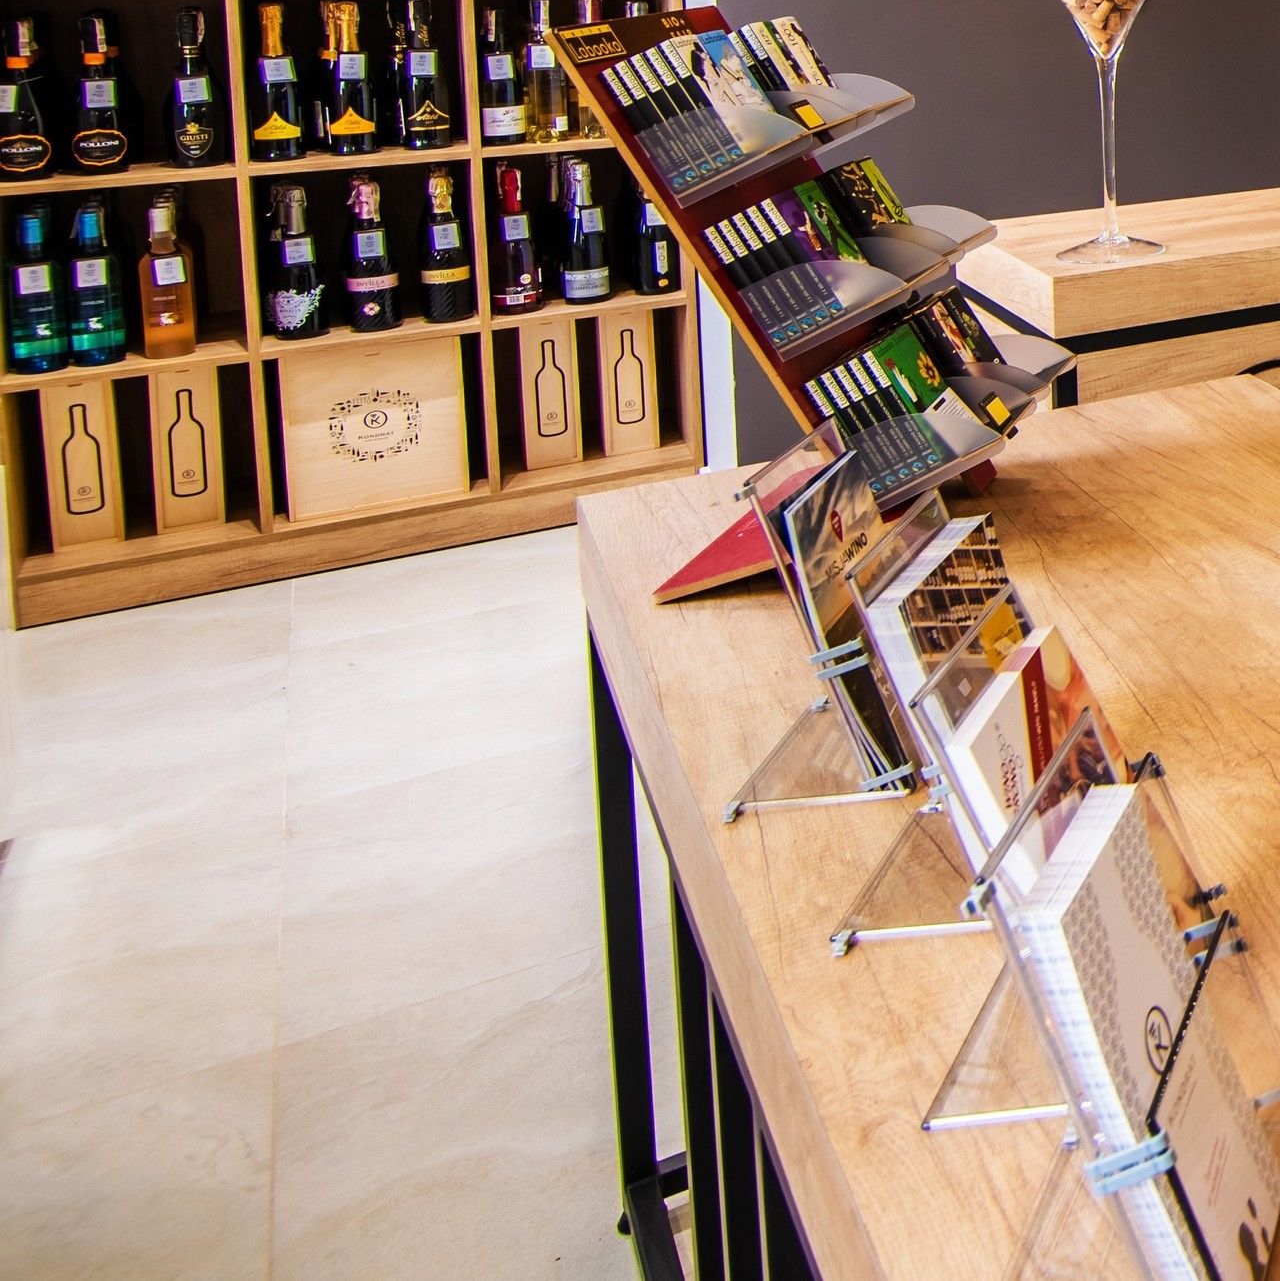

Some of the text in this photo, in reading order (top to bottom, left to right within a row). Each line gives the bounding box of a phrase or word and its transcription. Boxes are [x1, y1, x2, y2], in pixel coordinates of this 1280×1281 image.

[568, 39, 623, 61] Labooko
[666, 42, 692, 79] Labooko
[620, 63, 646, 101] Labooko
[636, 56, 662, 94] Labooko
[651, 50, 677, 87] Labooko
[607, 70, 634, 107] Labooko
[179, 133, 209, 142] GIUSTI
[736, 214, 764, 251] Labooko
[750, 208, 778, 244] Labooko
[765, 200, 792, 236] Labooko
[708, 229, 736, 265] Labooko
[722, 221, 750, 258] Labooko
[838, 367, 864, 403] Labooko
[852, 361, 878, 397] Labooko
[866, 353, 892, 389] Labooko
[809, 382, 836, 418] Labooko
[824, 373, 851, 410] Labooko
